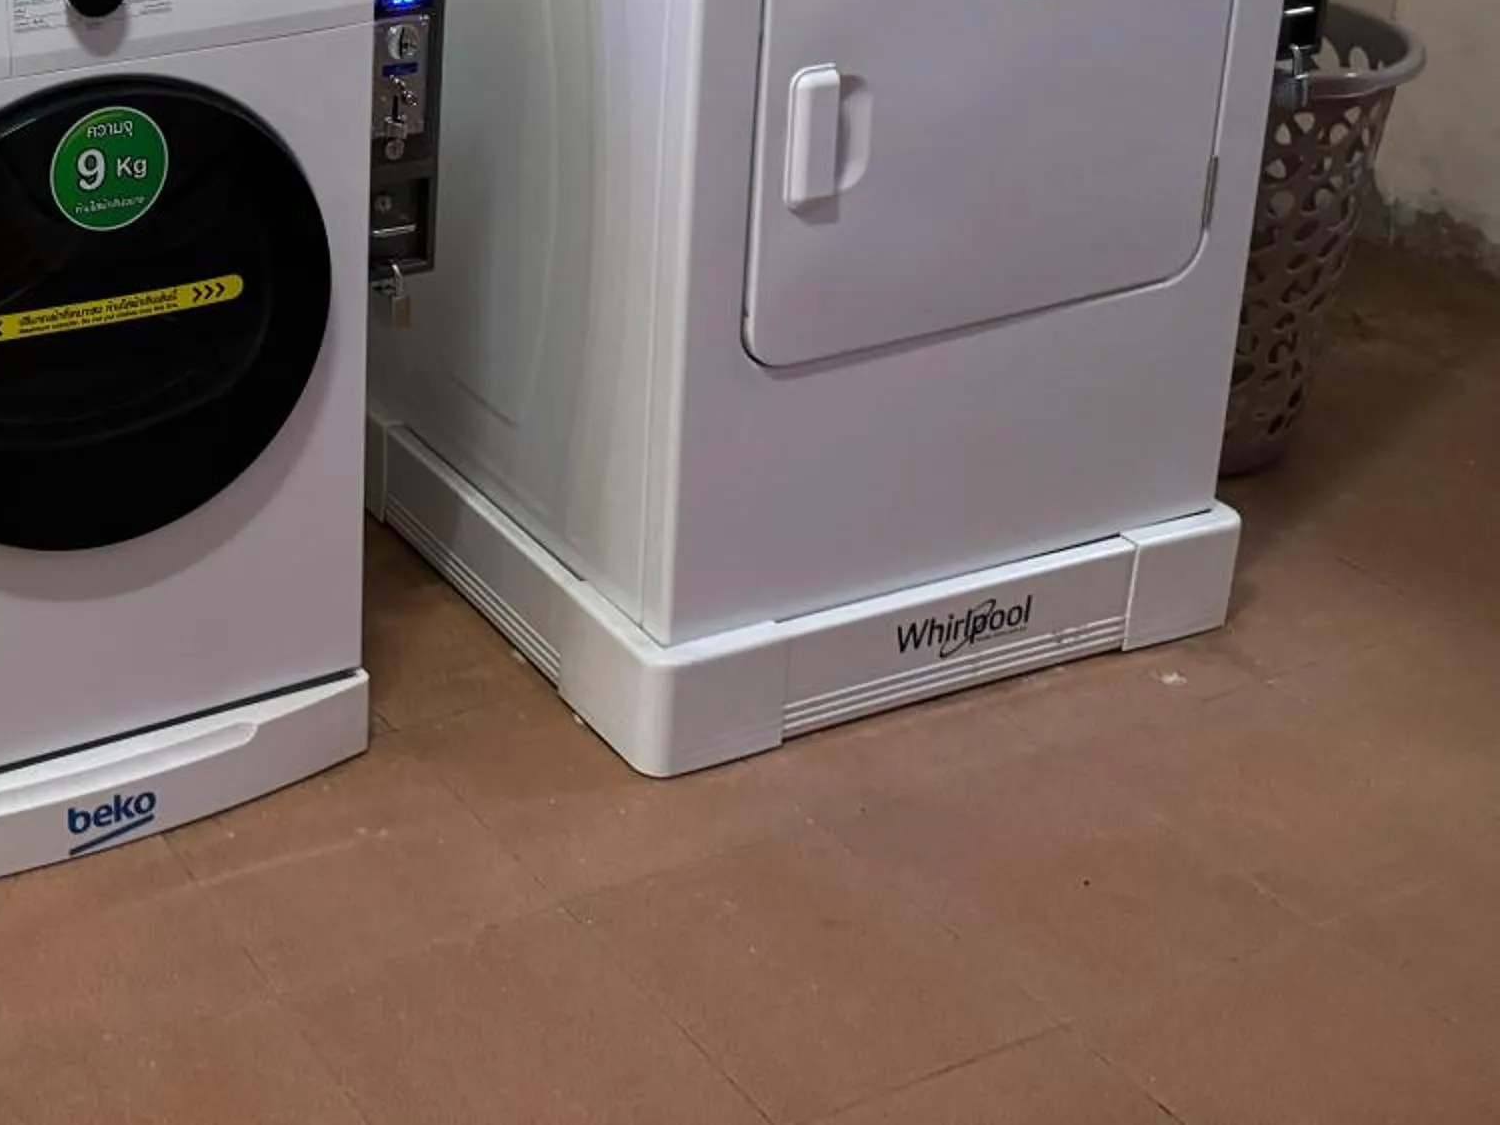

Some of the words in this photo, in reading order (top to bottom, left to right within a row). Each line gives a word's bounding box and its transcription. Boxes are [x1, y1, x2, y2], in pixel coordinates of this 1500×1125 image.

[87, 120, 134, 137] ความจุ
[77, 148, 105, 190] 9
[117, 156, 147, 179] Kg
[898, 595, 1033, 657] Whirlpool
[67, 791, 157, 834] beko
